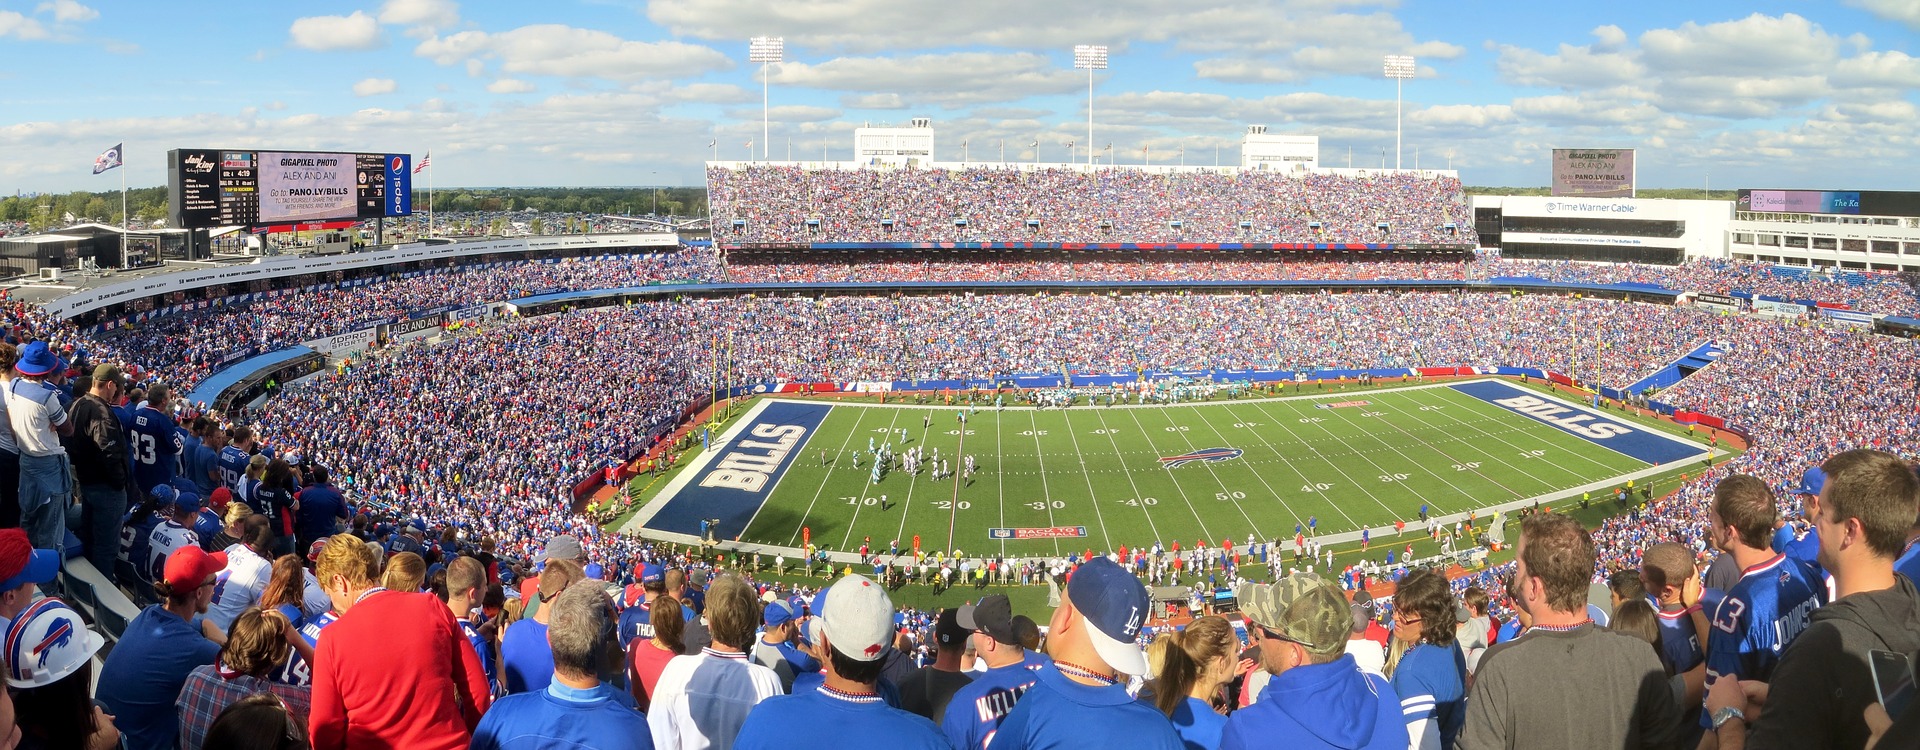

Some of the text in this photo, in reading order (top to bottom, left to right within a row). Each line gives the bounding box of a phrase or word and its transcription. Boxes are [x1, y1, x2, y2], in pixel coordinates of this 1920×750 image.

[283, 172, 336, 180] ALEX AND ANI
[289, 188, 348, 196] PANO.LY/BILLS
[394, 177, 403, 213] pepsi
[1579, 203, 1609, 211] Warner
[1611, 204, 1634, 212] Cable
[456, 305, 488, 320] GEICO
[393, 316, 439, 334] ALEX AND ANI
[332, 338, 367, 349] SPORTS
[136, 416, 148, 426] REED
[1493, 395, 1633, 439] BILLS
[698, 423, 807, 492] BILLS
[1519, 450, 1544, 458] 10
[1451, 461, 1480, 471] 20
[220, 465, 238, 494] 99
[1378, 473, 1408, 482] 30
[1301, 482, 1330, 493] 40
[846, 496, 878, 506] 10
[1215, 491, 1246, 500] 50
[938, 501, 971, 509] 20
[1033, 500, 1066, 510] 30
[1126, 498, 1158, 507] 40
[261, 500, 275, 518] 51
[153, 531, 172, 547] WATKINS
[1124, 606, 1140, 635] LA
[1713, 596, 1745, 634] 13
[282, 645, 310, 686] 14
